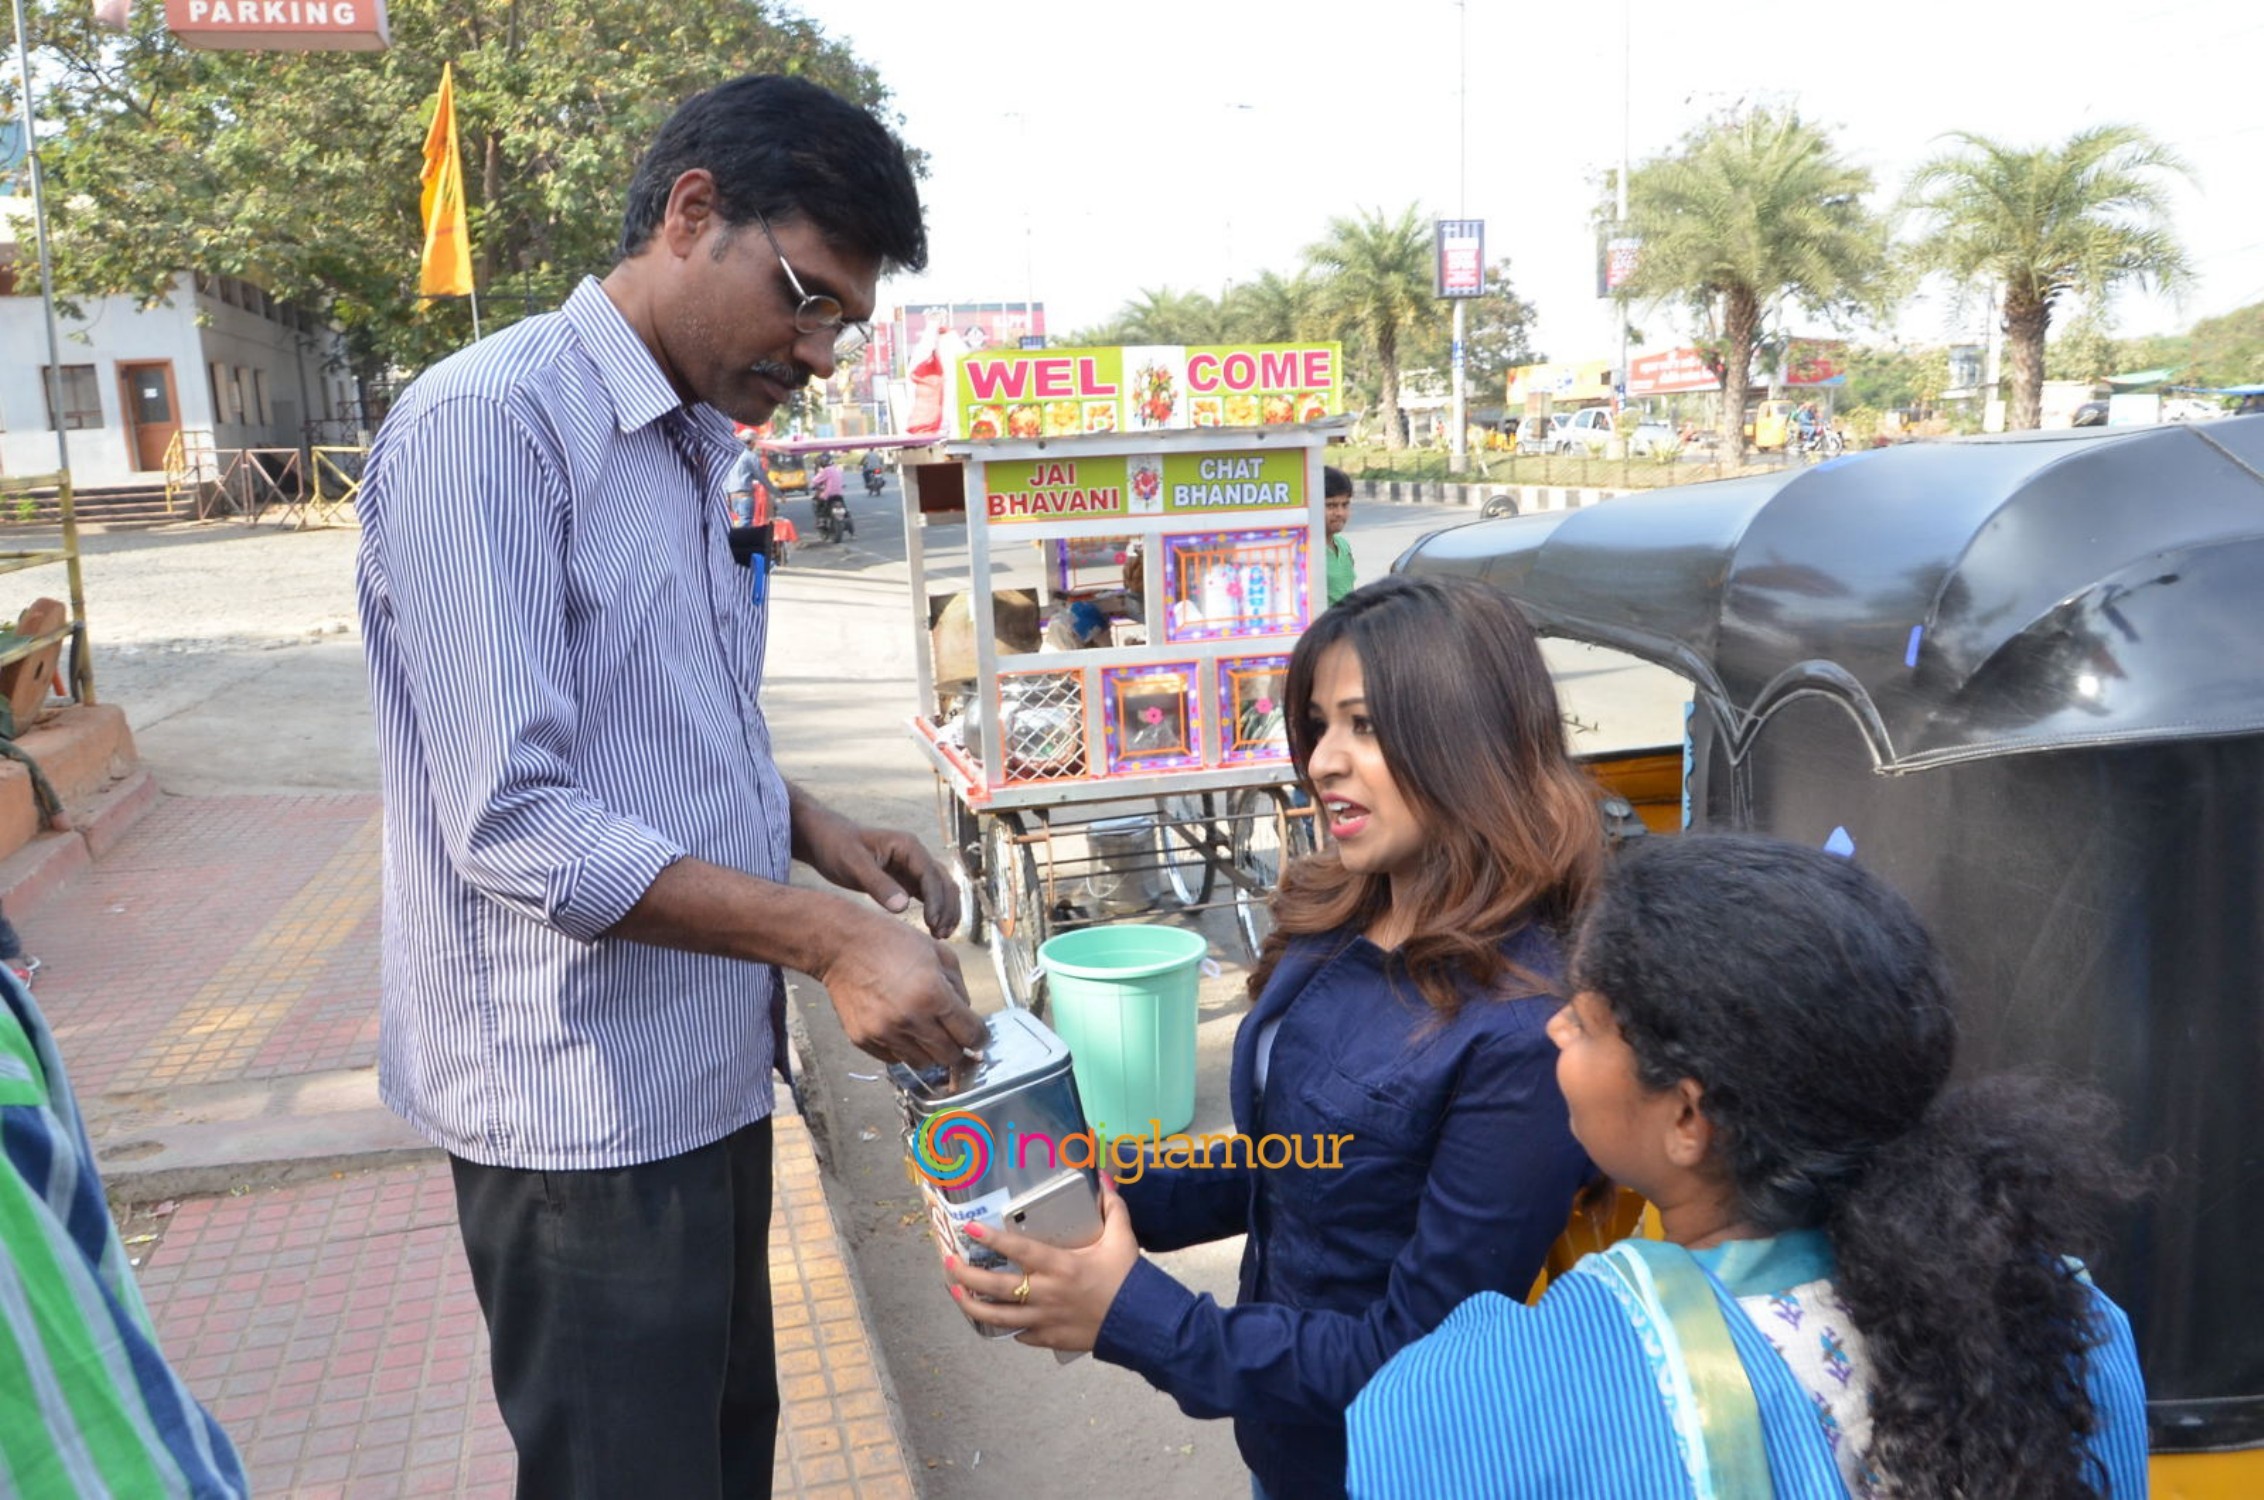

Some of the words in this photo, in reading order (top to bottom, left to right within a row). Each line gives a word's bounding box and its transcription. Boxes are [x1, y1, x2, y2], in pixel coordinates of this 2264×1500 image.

[188, 0, 355, 25] PARKING
[966, 358, 1117, 400] WEL
[1187, 350, 1332, 391] COME
[1029, 463, 1076, 488] JAI
[1199, 457, 1264, 481] CHAT
[988, 488, 1120, 517] BHAVANI
[1173, 483, 1290, 508] BHANDAR
